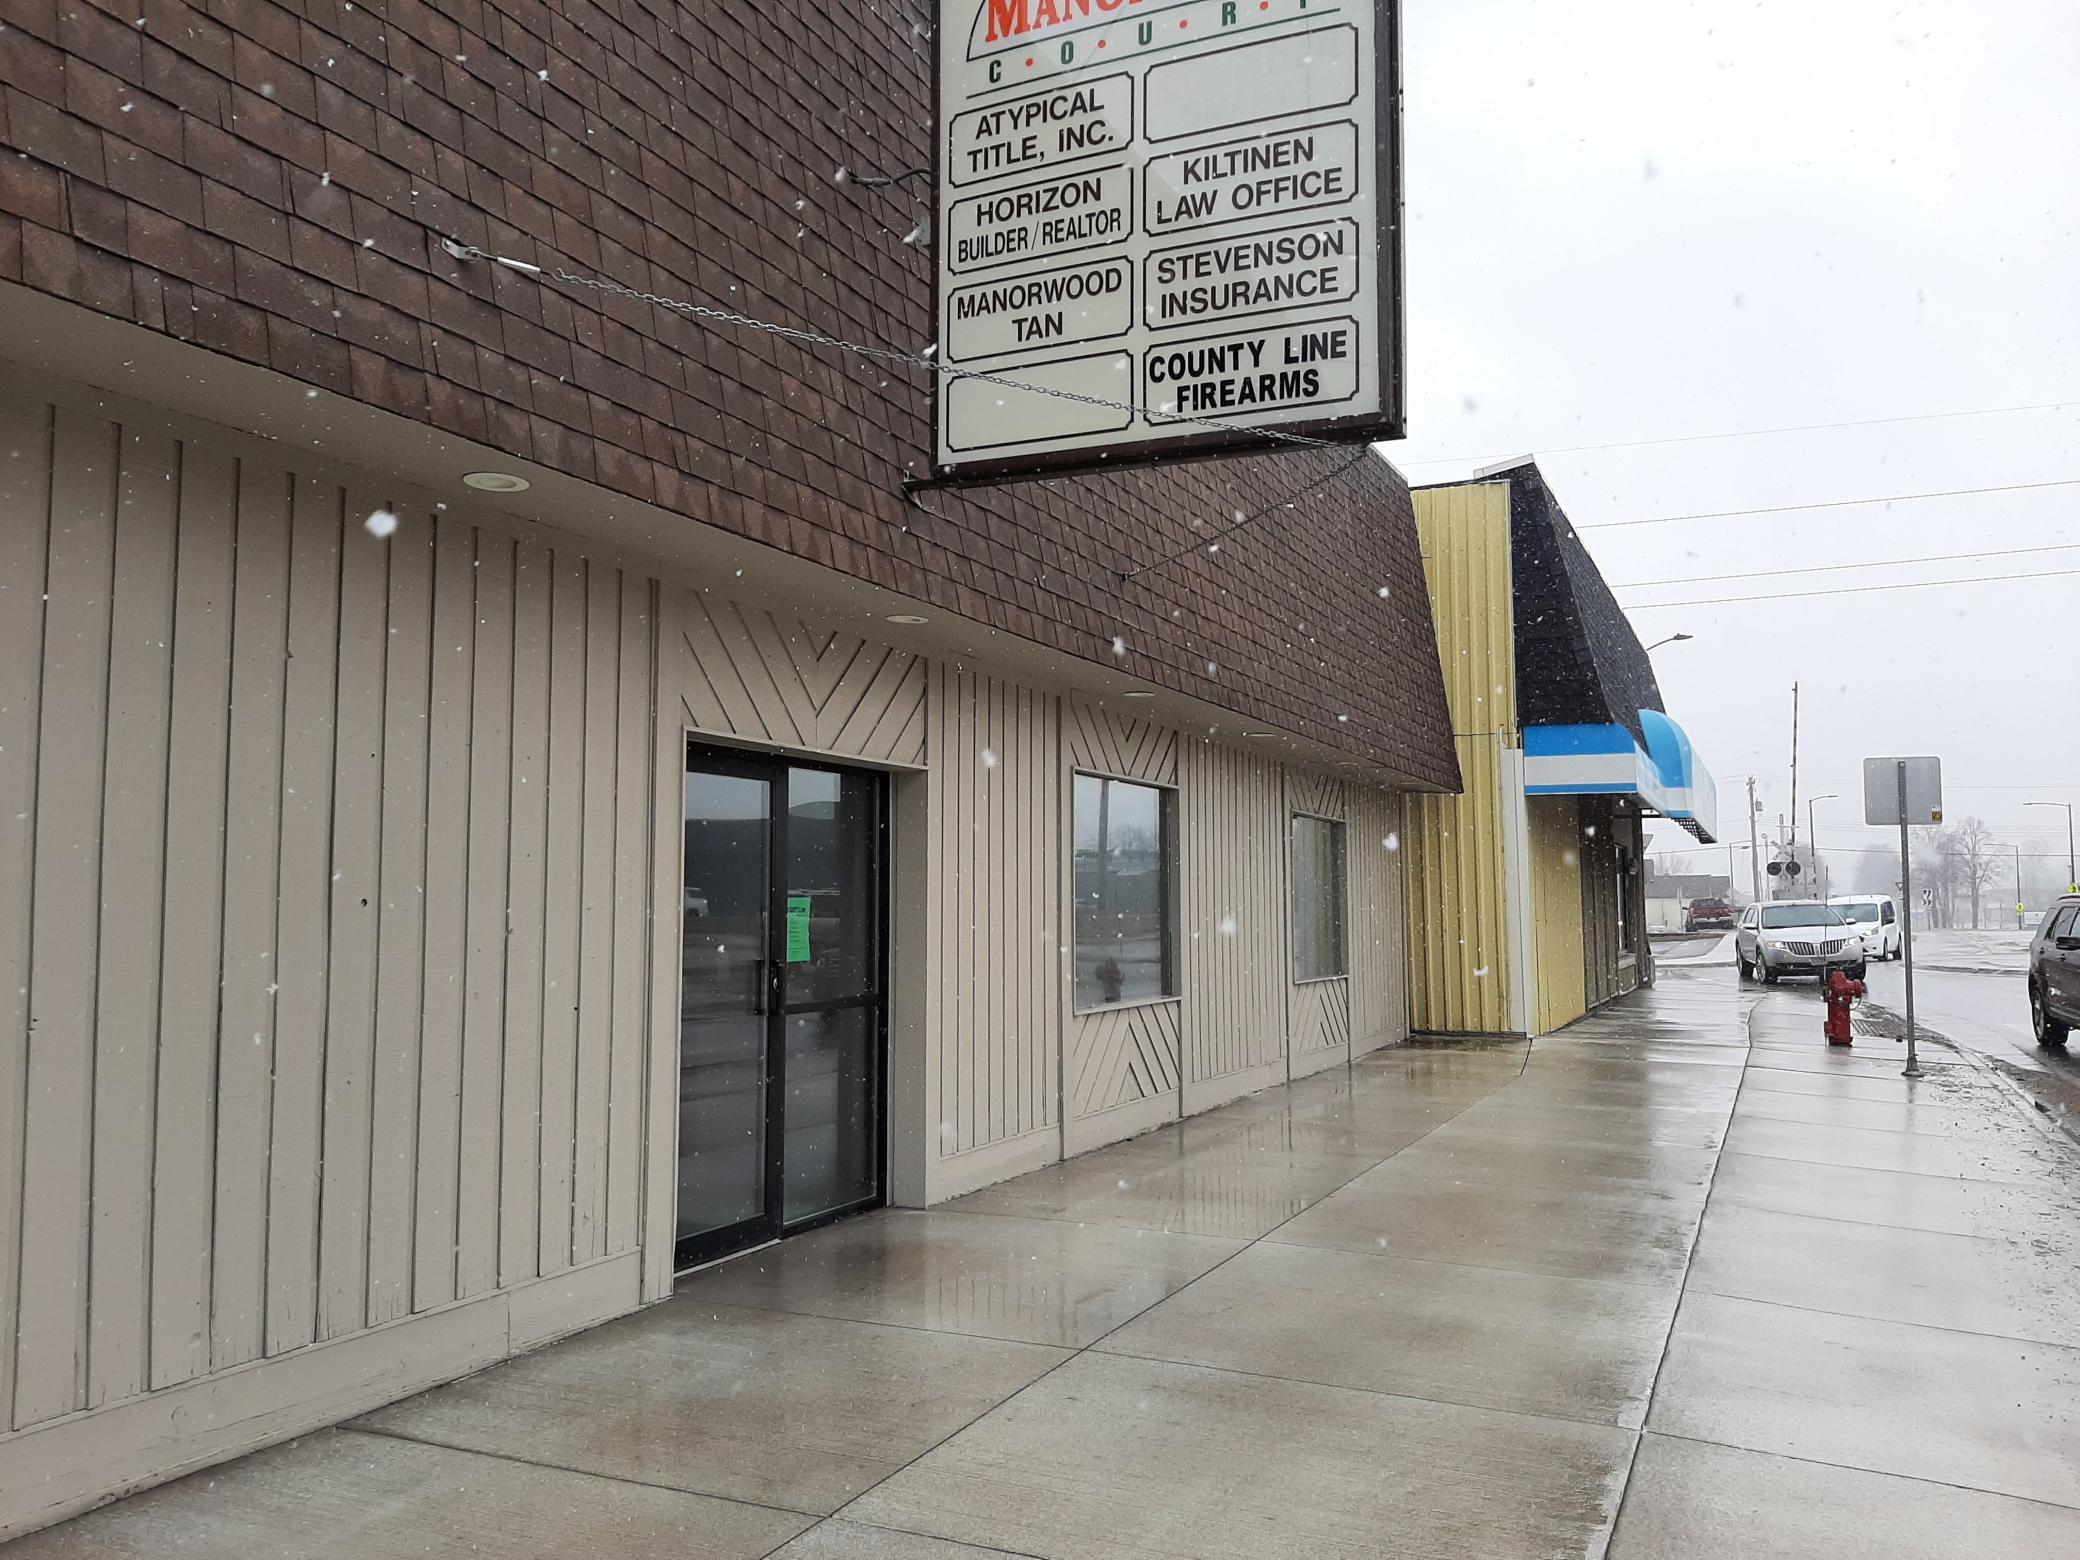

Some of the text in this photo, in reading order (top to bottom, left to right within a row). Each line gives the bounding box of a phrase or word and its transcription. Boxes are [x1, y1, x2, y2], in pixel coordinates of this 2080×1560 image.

[975, 87, 1105, 141] ATYPICAL
[966, 119, 1114, 173] TITLE, INC.
[1183, 136, 1314, 185] KILTINEN
[976, 177, 1102, 227] HORIZON
[1156, 166, 1343, 225] LAW OFFICE
[1157, 228, 1344, 285] STEVENSON
[957, 267, 1123, 321] MANORWOOD
[1161, 266, 1339, 319] INSURANCE
[1011, 311, 1063, 343] TAN
[1148, 329, 1348, 384] COUNTY LINE
[1176, 368, 1320, 414] FIREARMS
